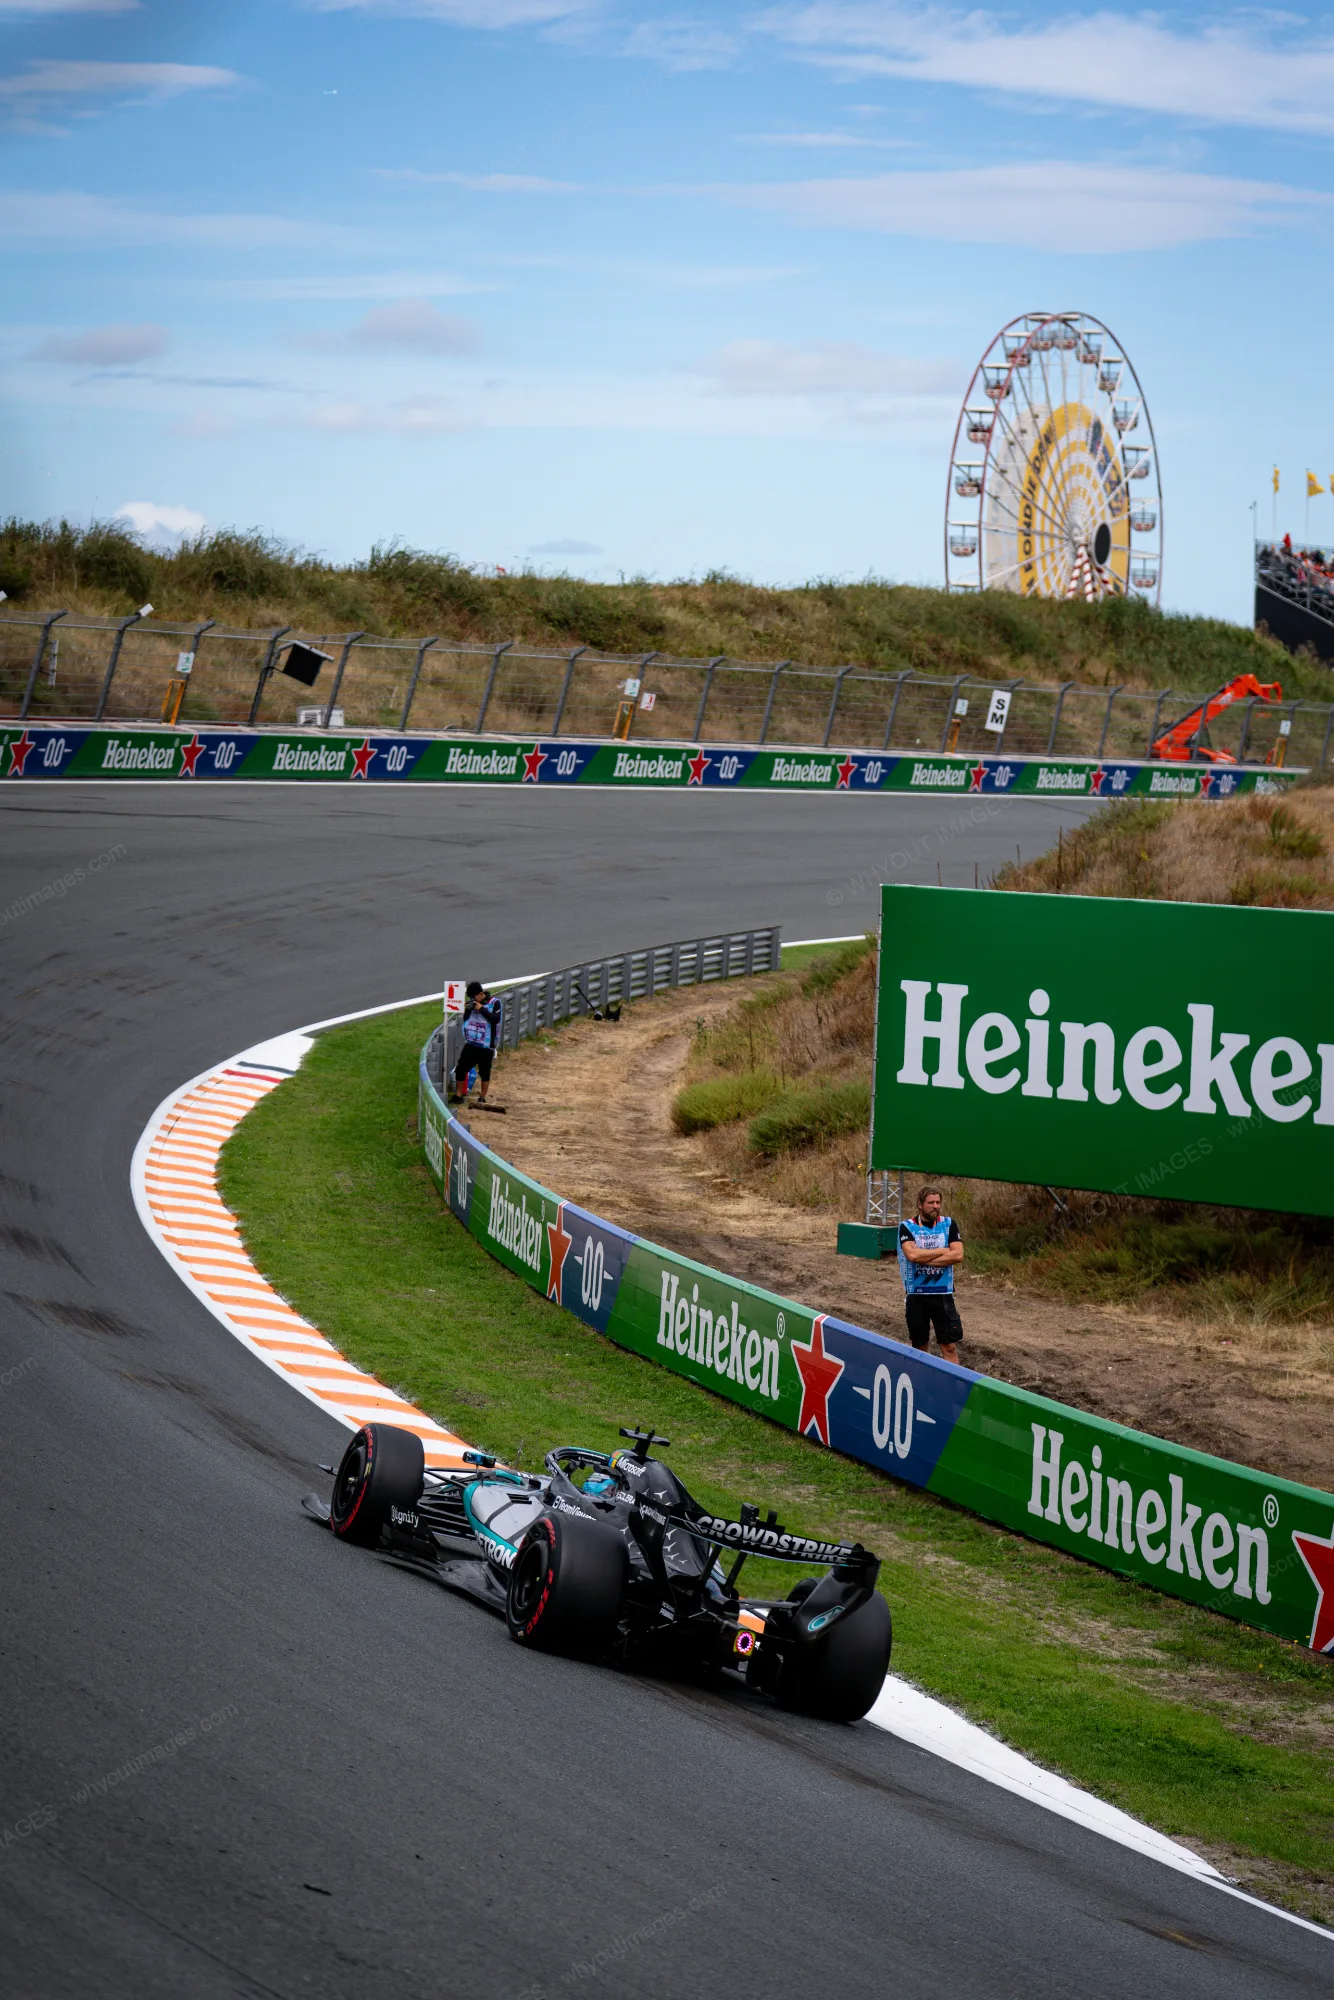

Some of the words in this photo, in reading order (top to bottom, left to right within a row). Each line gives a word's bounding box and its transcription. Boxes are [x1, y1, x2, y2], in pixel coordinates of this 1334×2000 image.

[995, 698, 1006, 710] S
[990, 711, 1005, 725] M
[101, 739, 174, 769] Heineken
[273, 743, 346, 771] Heineken
[446, 747, 516, 775] Heineken
[613, 752, 682, 779] Heineken
[770, 758, 831, 782] Heineken
[910, 763, 965, 786] Heineken
[581, 1235, 604, 1311] 0.0
[872, 1363, 914, 1459] 0.0
[617, 1456, 647, 1477] Microsoft
[696, 1515, 853, 1564] CROWDSTRIKE
